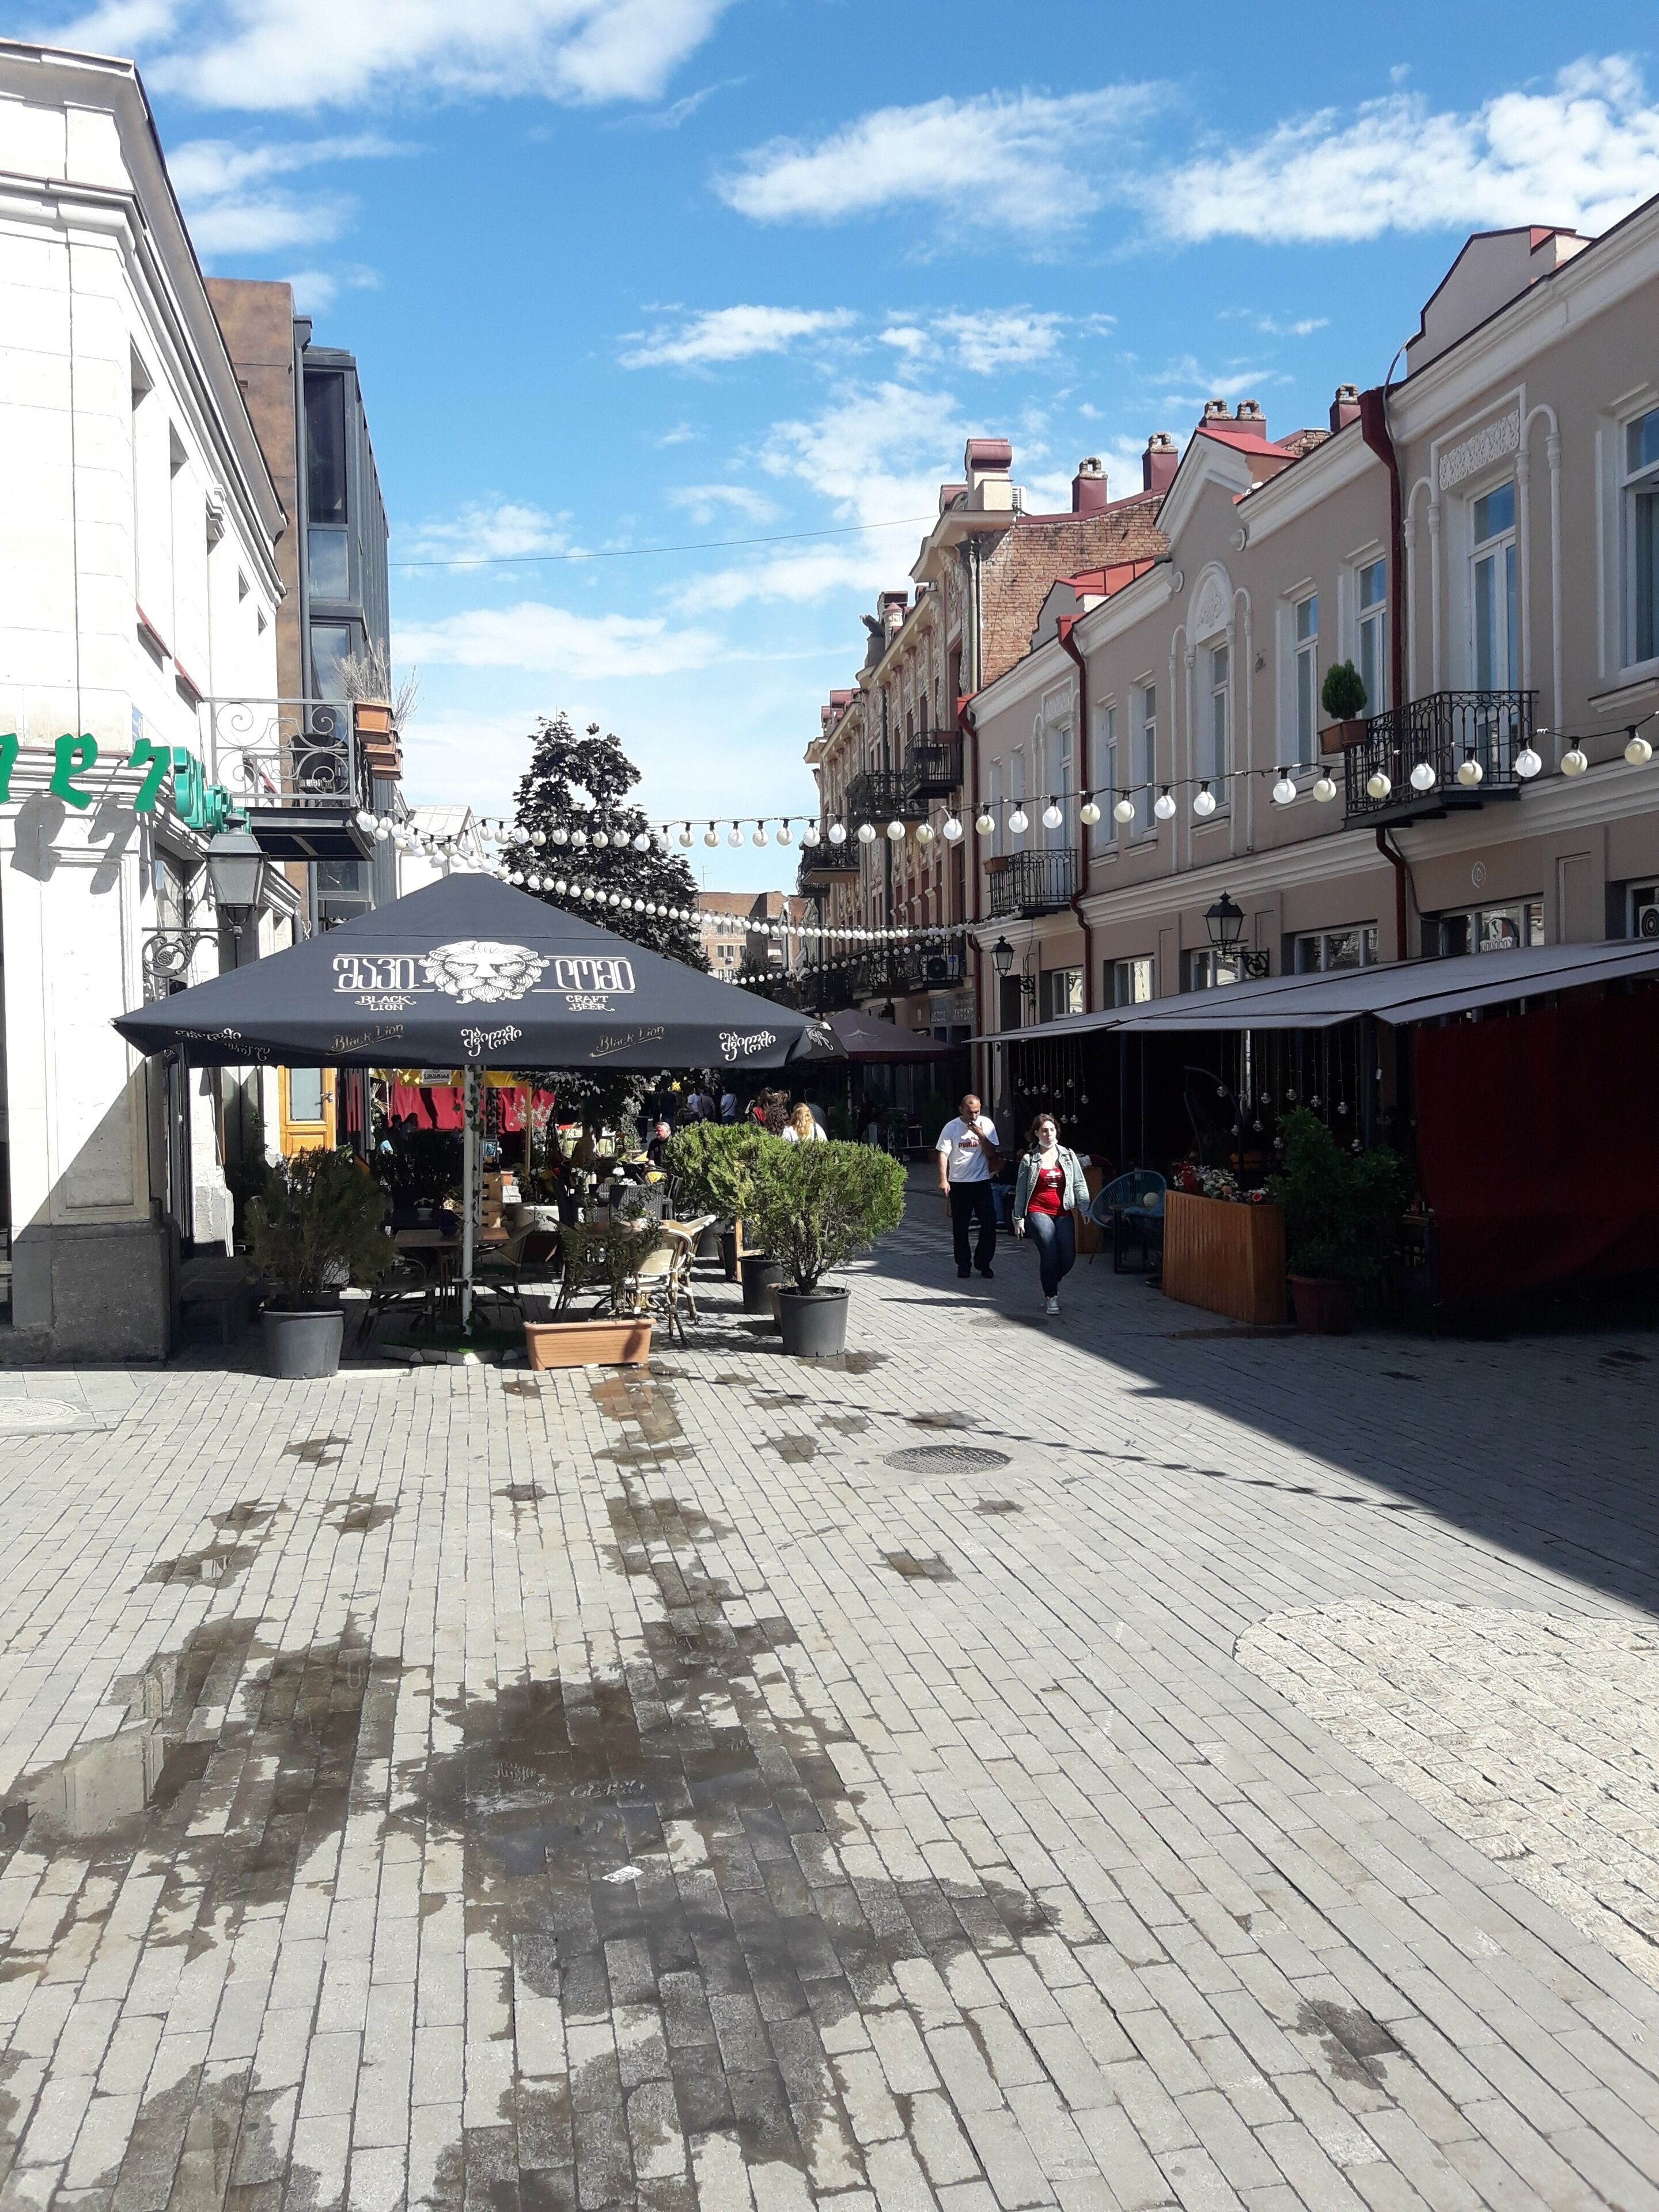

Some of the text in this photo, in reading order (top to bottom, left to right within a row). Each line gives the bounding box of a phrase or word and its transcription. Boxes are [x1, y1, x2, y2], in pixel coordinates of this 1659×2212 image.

[332, 958, 636, 990] შავი ლომი
[355, 995, 416, 1005] BLACK
[566, 995, 609, 1004] CRAFT
[569, 1003, 615, 1012] BEER
[331, 1024, 406, 1052] Black Lion
[596, 1026, 665, 1052] Black Lion
